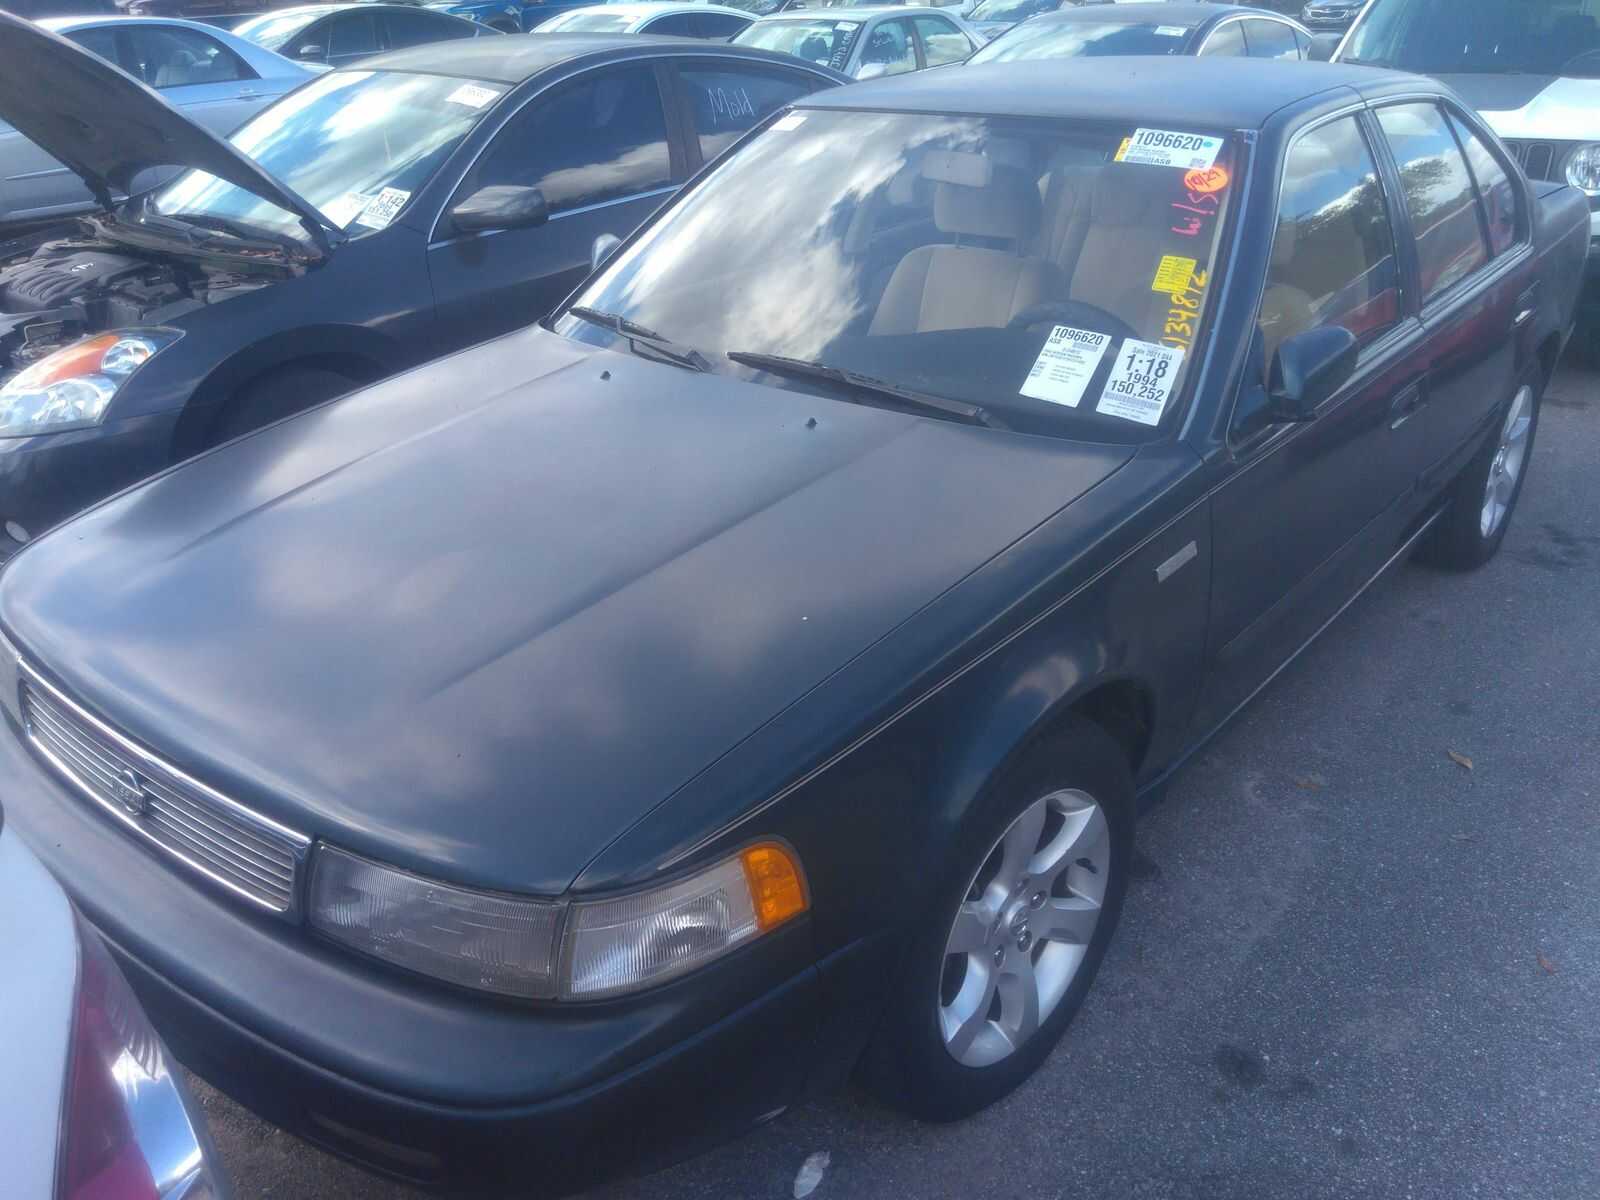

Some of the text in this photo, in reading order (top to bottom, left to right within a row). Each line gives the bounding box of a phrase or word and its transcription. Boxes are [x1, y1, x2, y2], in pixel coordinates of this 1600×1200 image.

[1136, 132, 1203, 151] 1096620
[1054, 327, 1104, 346] 1096620
[1126, 353, 1169, 378] 1:18
[1127, 372, 1158, 387] 1994
